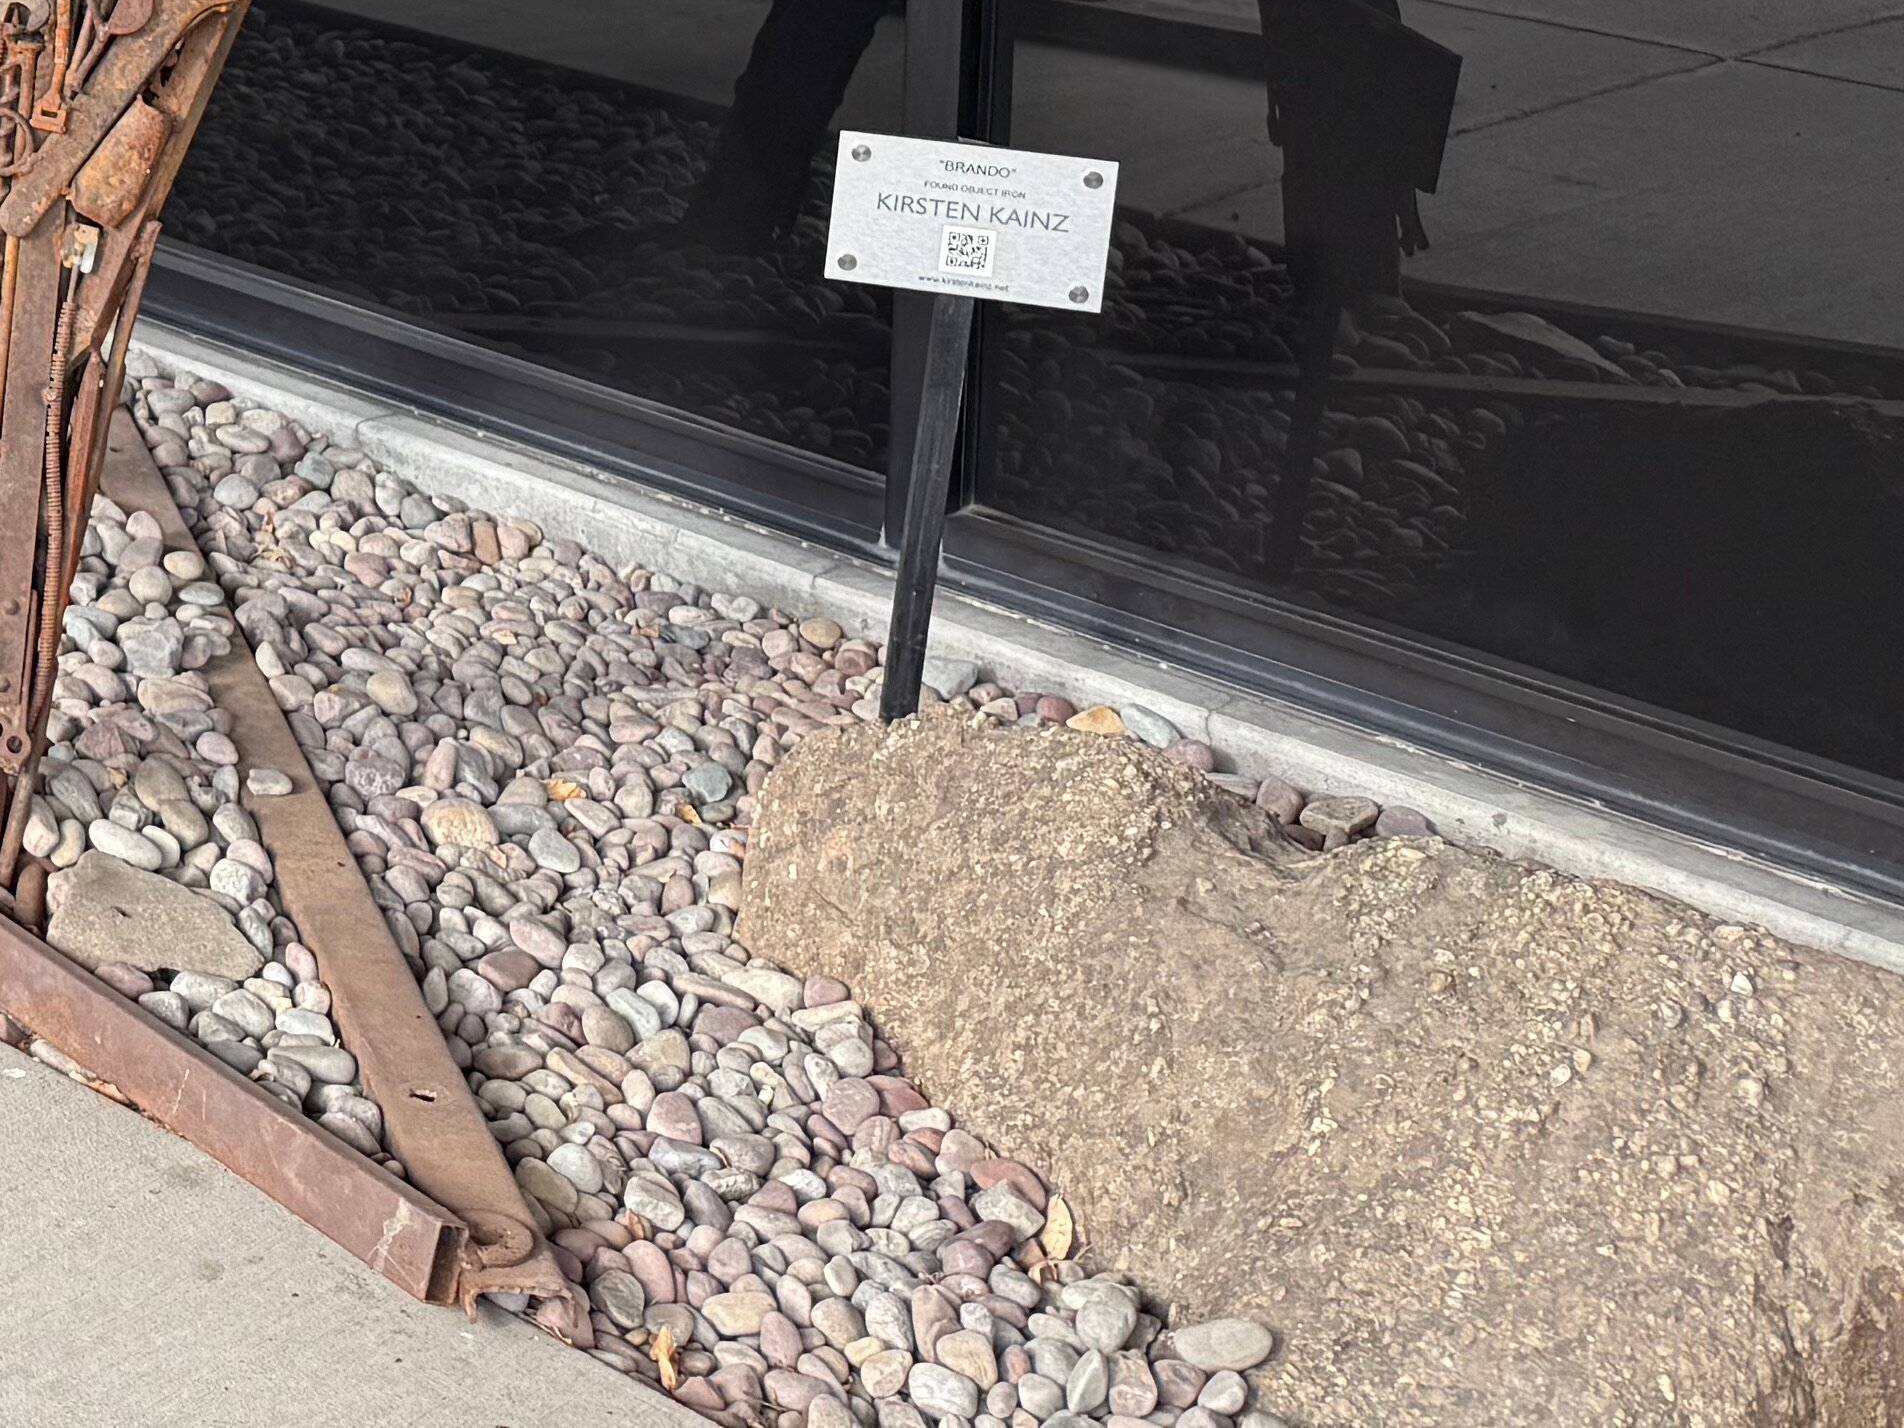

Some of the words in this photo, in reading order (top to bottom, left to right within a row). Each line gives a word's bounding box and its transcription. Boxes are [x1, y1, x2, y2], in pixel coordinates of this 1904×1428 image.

[939, 159, 1017, 178] "BRANDO"
[923, 180, 959, 192] FOUND
[960, 184, 999, 196] OBJECT
[1001, 189, 1026, 199] IRON
[876, 192, 981, 222] KIRSTEN
[988, 205, 1070, 233] KAINZ
